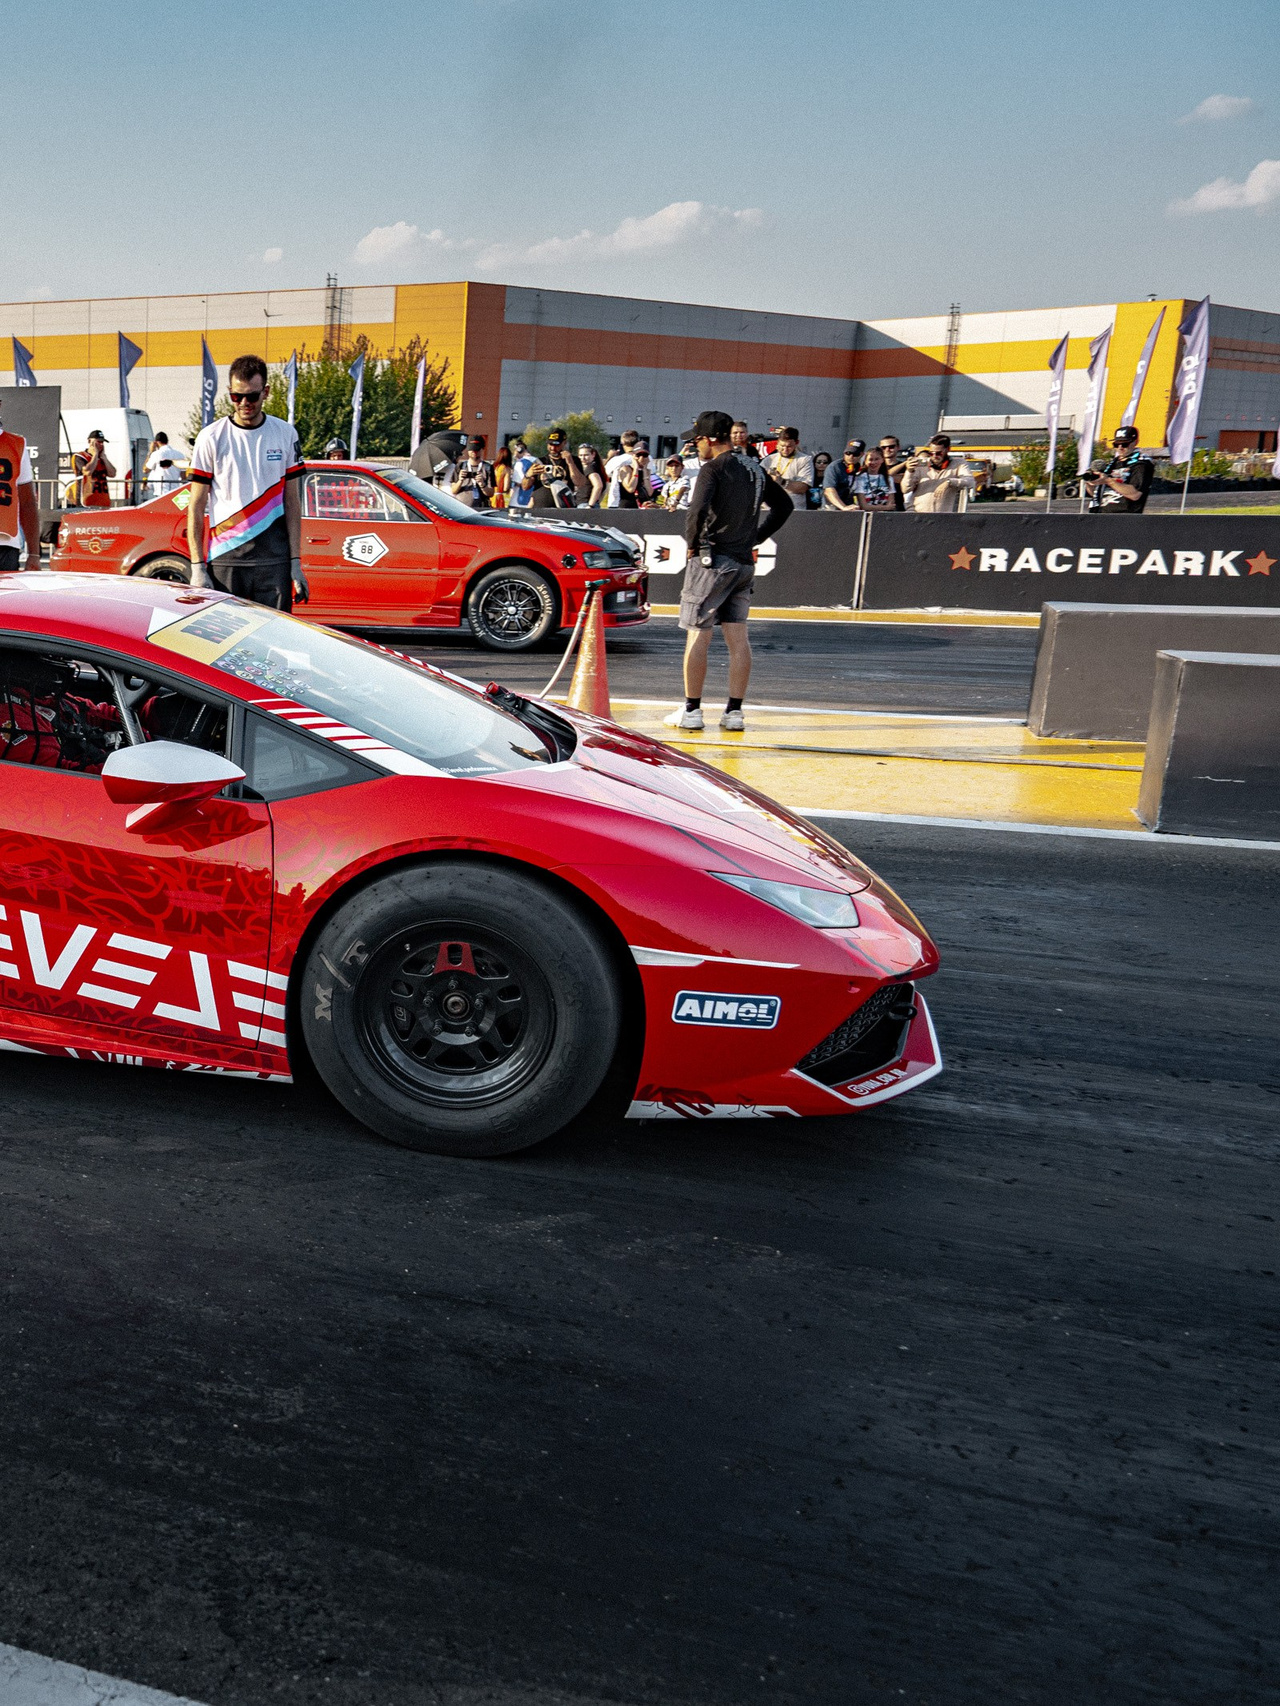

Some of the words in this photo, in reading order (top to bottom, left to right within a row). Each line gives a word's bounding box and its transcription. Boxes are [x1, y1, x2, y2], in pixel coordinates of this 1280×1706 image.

[75, 526, 120, 535] RACESNAB
[361, 545, 373, 554] 88
[978, 547, 1244, 577] RACEPARK
[676, 998, 773, 1023] AIMOL
